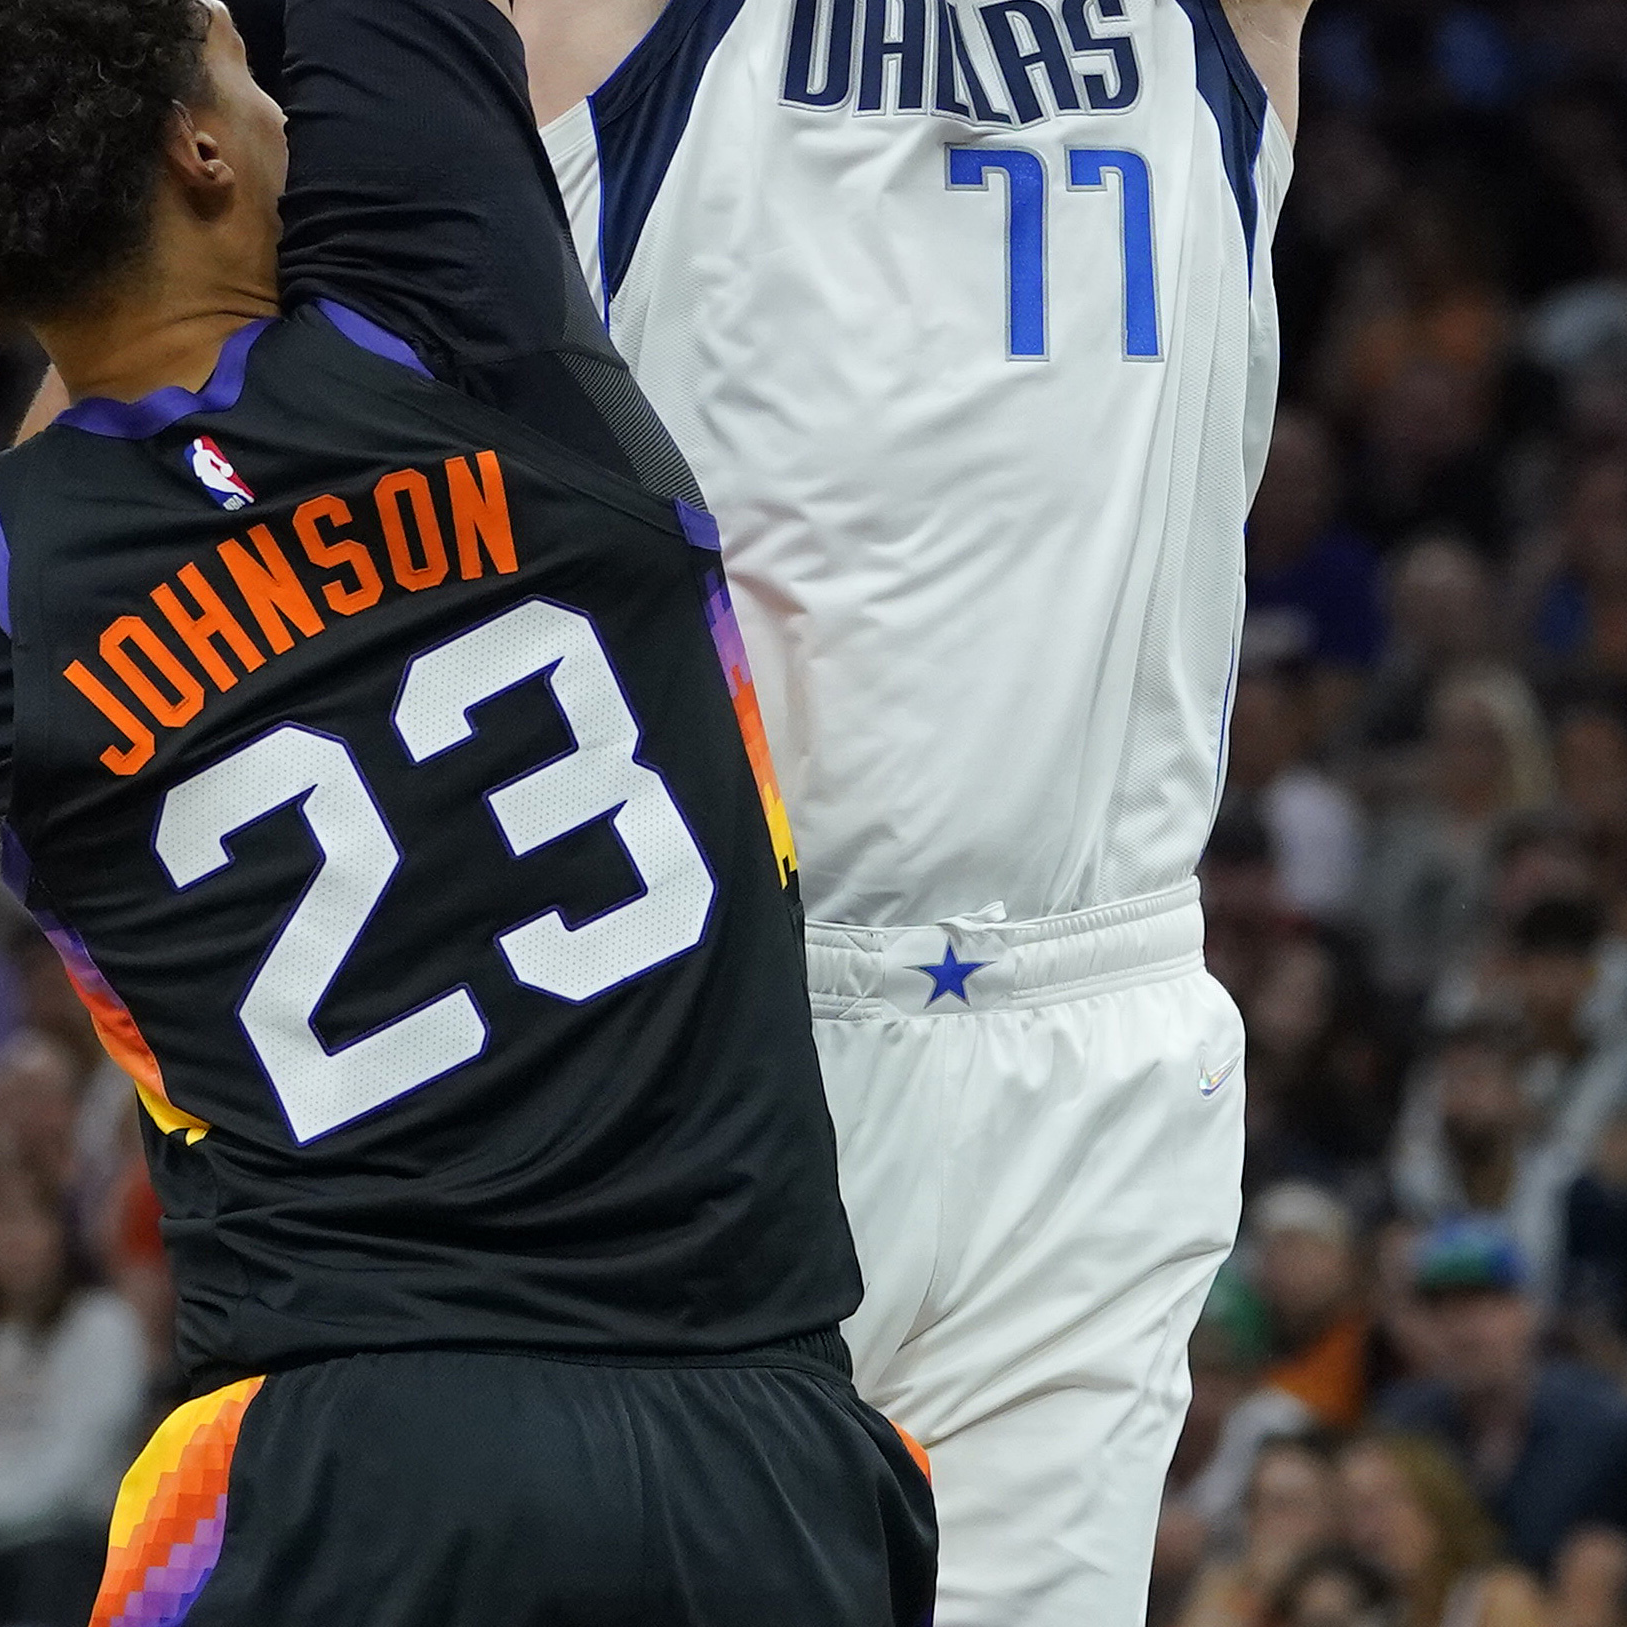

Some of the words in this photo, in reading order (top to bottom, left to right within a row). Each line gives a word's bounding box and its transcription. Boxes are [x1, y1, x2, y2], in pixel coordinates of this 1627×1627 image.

[944, 143, 1165, 364] 77
[62, 450, 518, 777] JOHNSON
[150, 593, 719, 1147] 23
